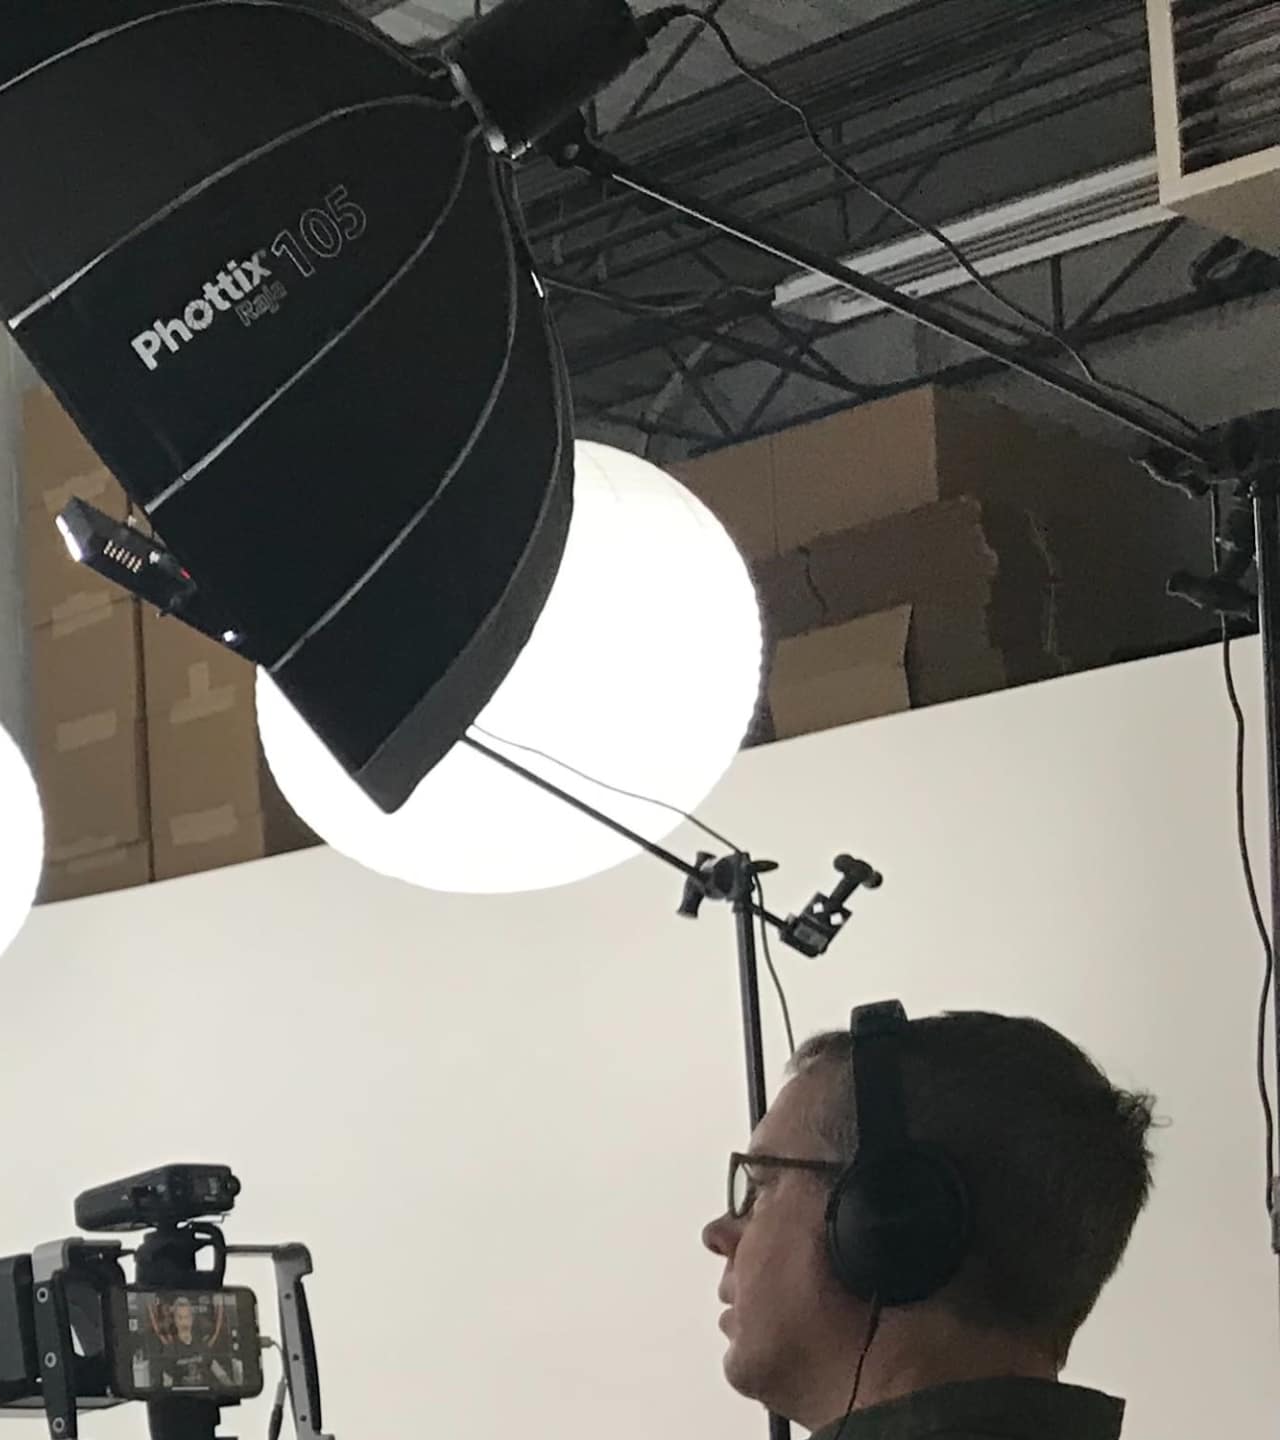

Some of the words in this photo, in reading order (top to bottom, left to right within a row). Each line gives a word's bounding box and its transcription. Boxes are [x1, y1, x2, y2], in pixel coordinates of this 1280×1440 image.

[130, 253, 272, 371] Phottix
[270, 184, 366, 277] 105
[235, 281, 287, 327] Raja
